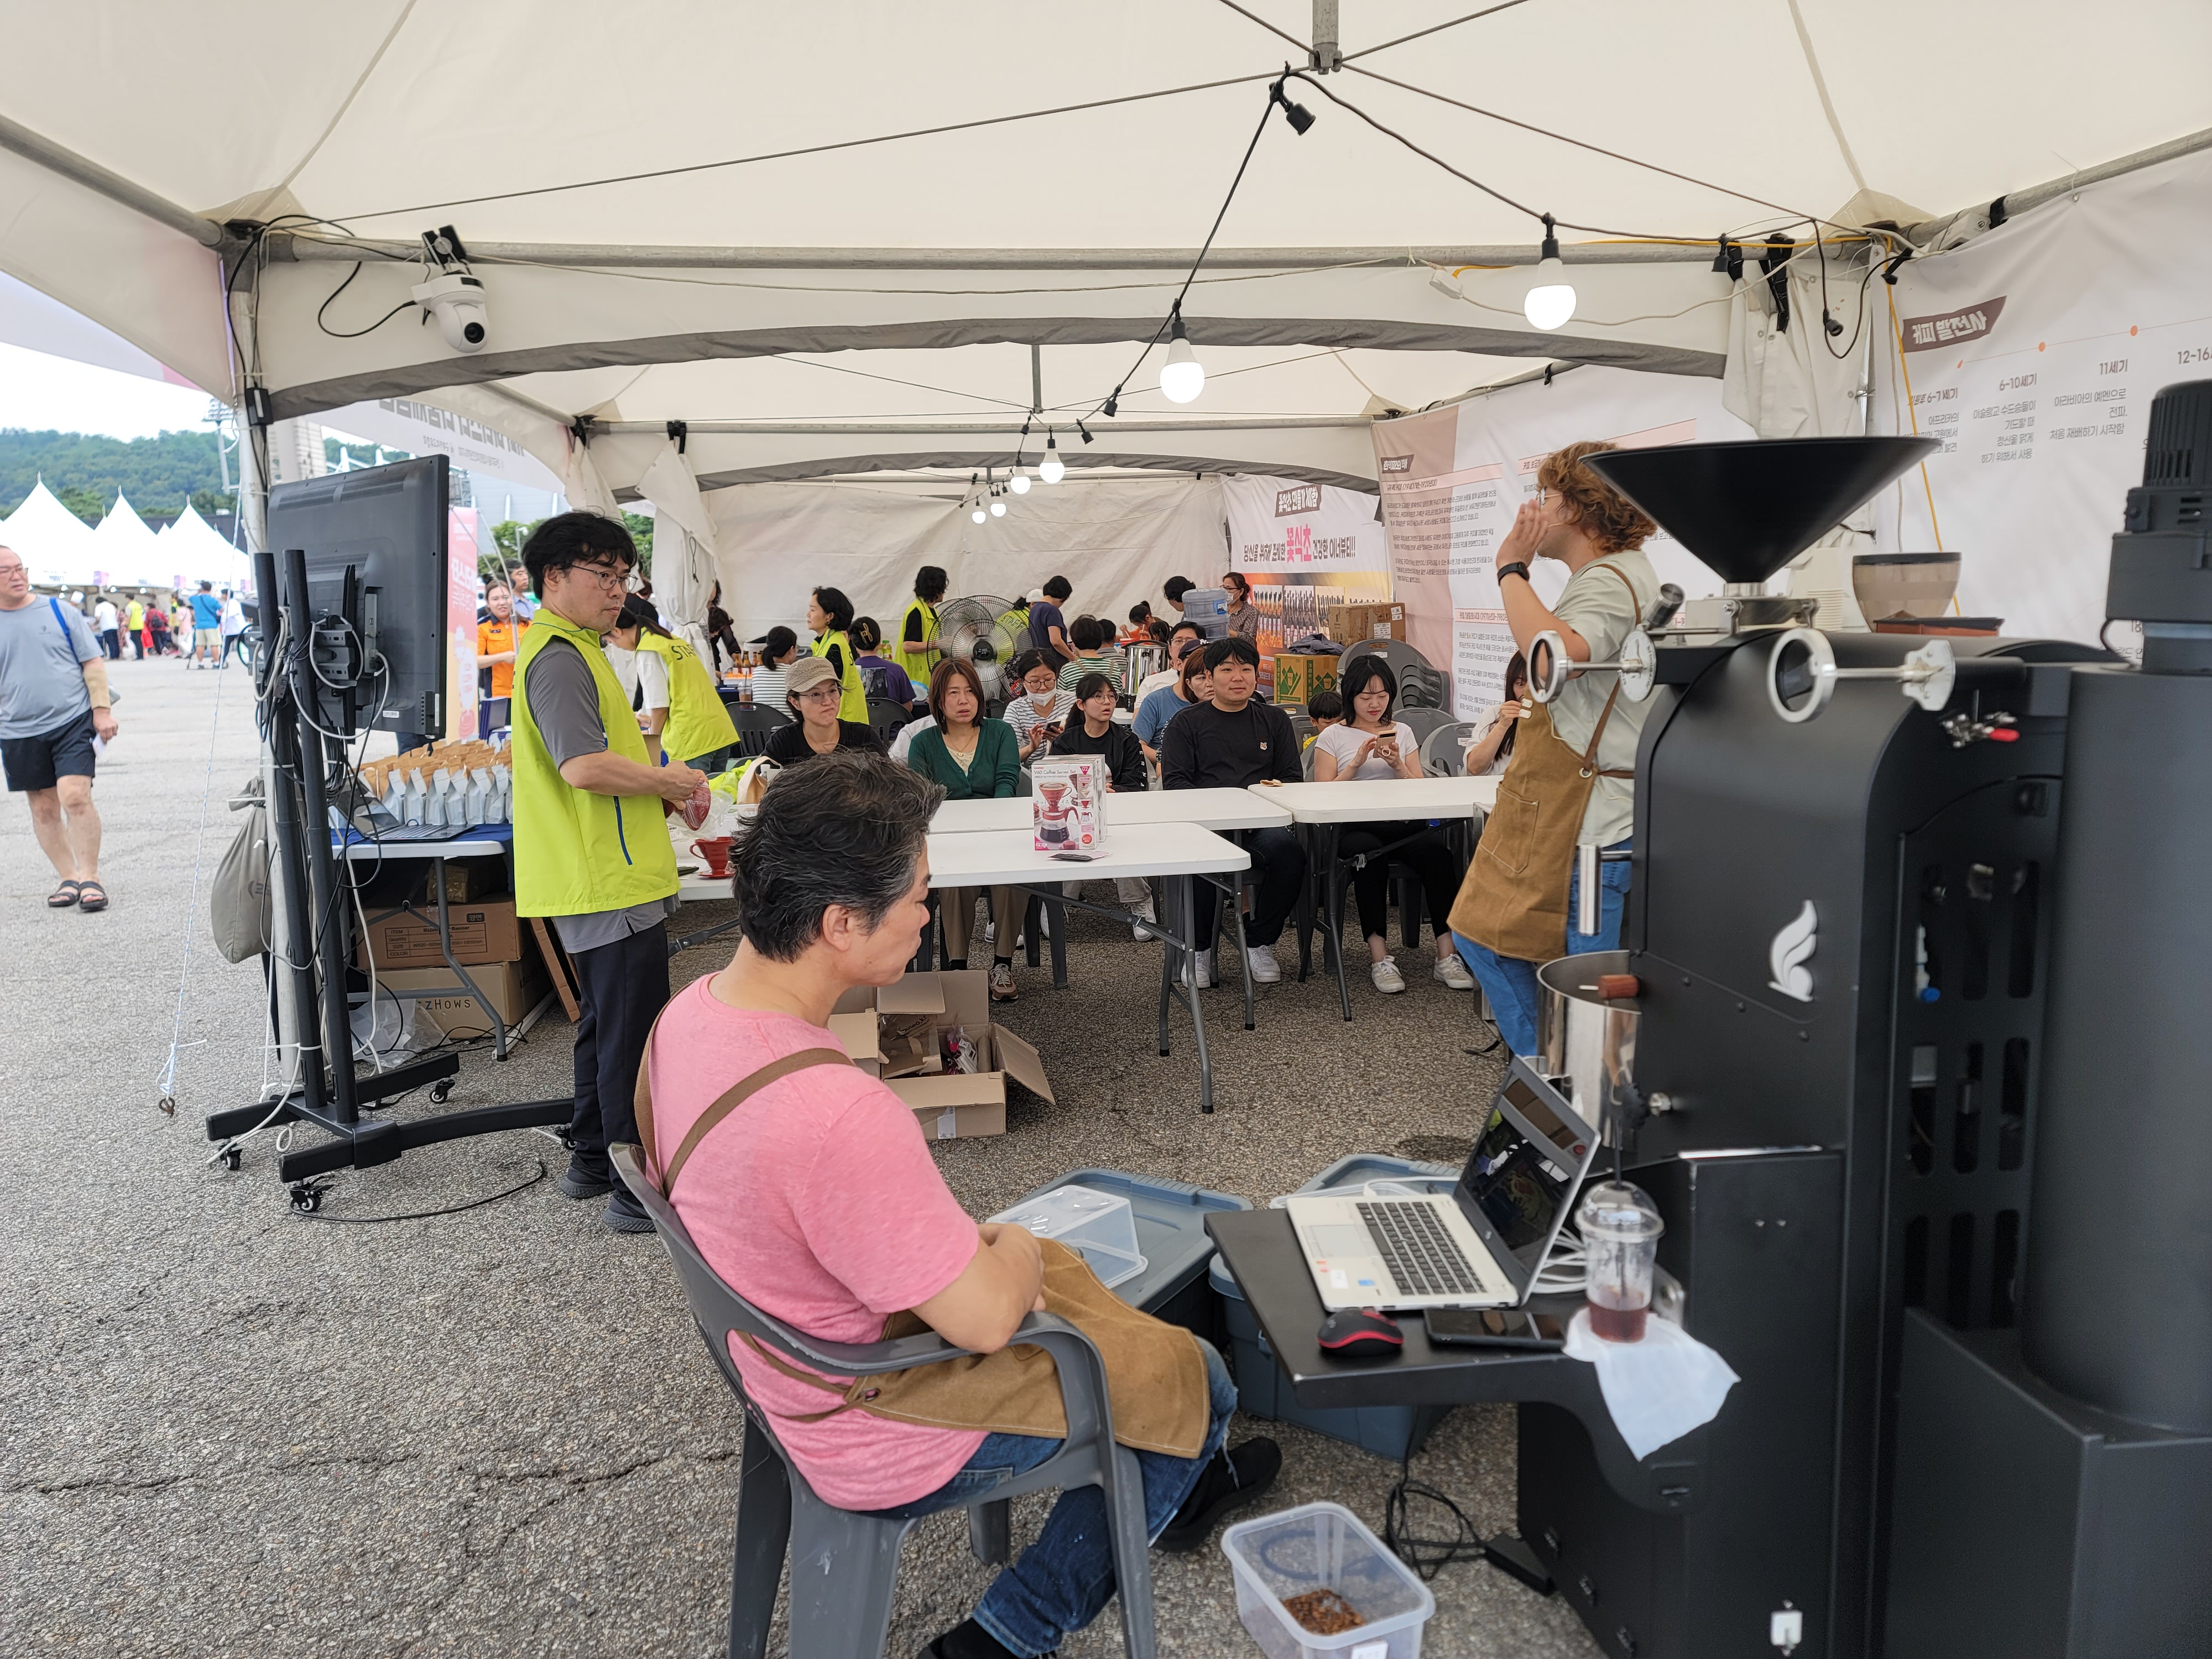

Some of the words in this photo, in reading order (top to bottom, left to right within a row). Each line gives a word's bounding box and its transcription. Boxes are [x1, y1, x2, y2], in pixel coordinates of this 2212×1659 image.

[2099, 358, 2128, 375] 11세기
[2054, 392, 2093, 406] 아라비아의
[2093, 388, 2127, 402] 예멘으로
[1973, 406, 2000, 419] 이슬람교
[2000, 399, 2036, 415] 수도승들이
[2109, 405, 2128, 419] 전파.
[1928, 411, 1959, 426] 아프리카의
[2004, 418, 2027, 430] 기도할
[2027, 416, 2035, 427] 때
[1996, 435, 2017, 447] 정신을
[2018, 432, 2034, 444] 맑게
[2048, 428, 2065, 440] 처음
[2066, 425, 2098, 438] 재배하기
[2099, 423, 2125, 436] 시작함
[1944, 442, 1957, 453] 발견
[1981, 453, 1994, 463] 하기
[1995, 451, 2016, 462] 위해서
[2017, 448, 2033, 460] 사용
[1279, 491, 1292, 513] 꽃식초
[1292, 488, 1306, 510] 만들기
[1306, 486, 1318, 508] 체험
[1244, 544, 1259, 562] 당신을
[1259, 543, 1272, 562] 위해
[1272, 542, 1286, 562] 준비한
[1286, 523, 1312, 563] 꽃식초
[1312, 538, 1328, 560] 건강한
[1329, 535, 1356, 559] 이너뷰티!!
